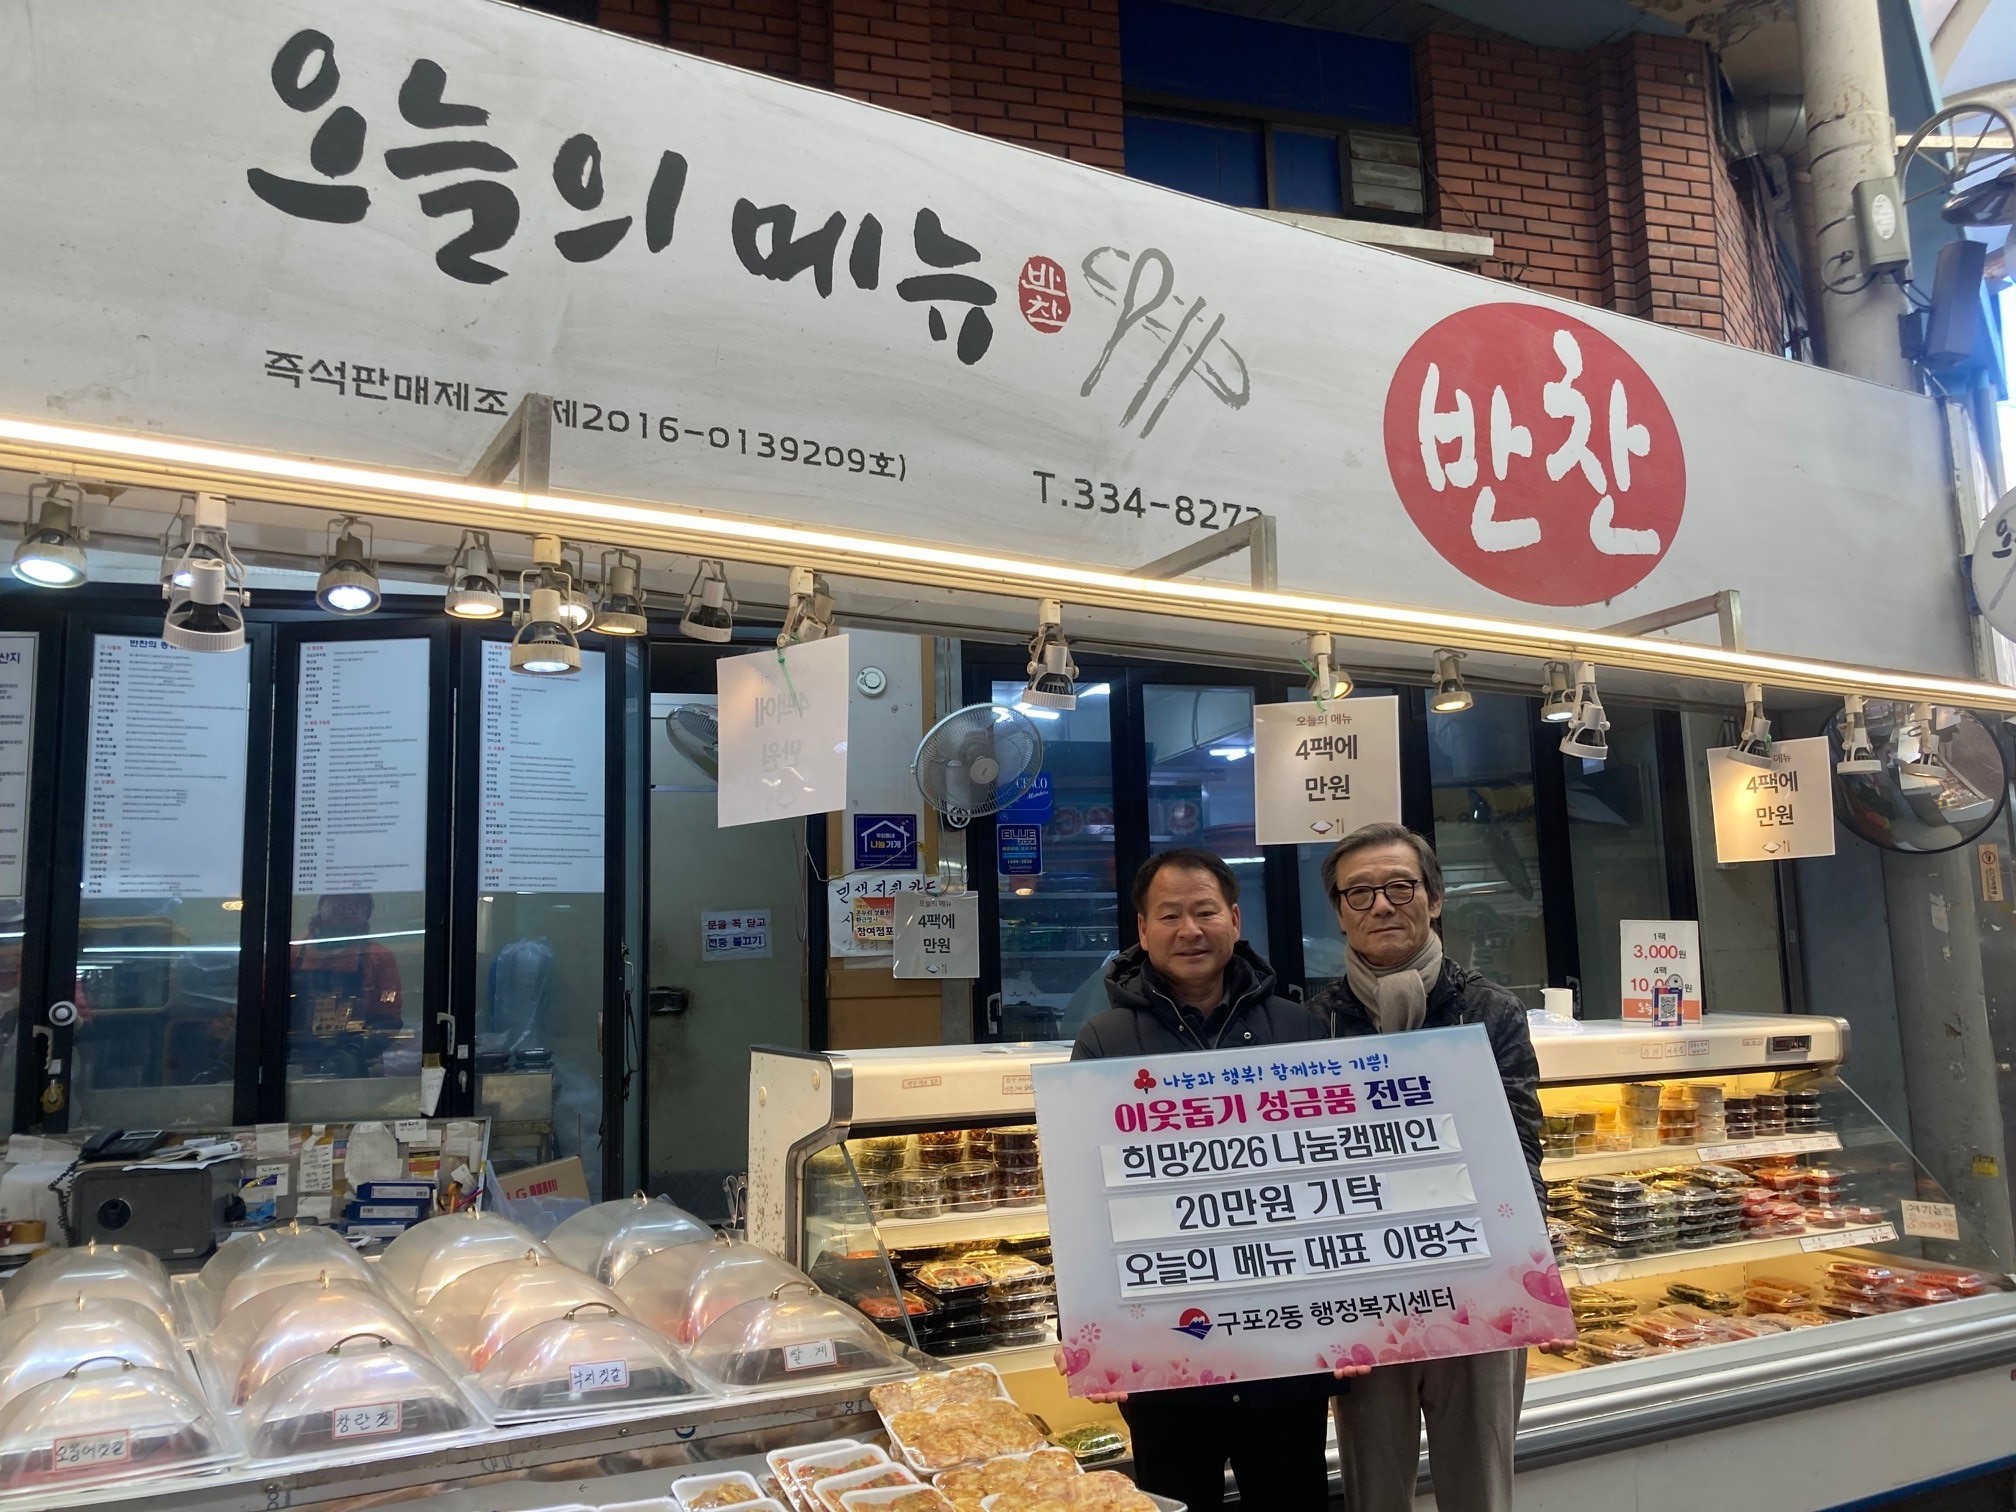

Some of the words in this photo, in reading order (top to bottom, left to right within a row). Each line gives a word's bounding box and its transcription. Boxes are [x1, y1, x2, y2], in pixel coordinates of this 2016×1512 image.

[247, 28, 687, 285] 오늘의
[732, 198, 997, 364] 메뉴
[265, 350, 508, 416] 즉석판매제조
[1418, 330, 1660, 555] 반찬
[1296, 715, 1327, 727] 오늘의
[1331, 713, 1352, 725] 메뉴
[1295, 734, 1357, 761] 4팩에
[1305, 774, 1350, 802] 만원
[1746, 771, 1798, 793] 4팩에
[1756, 804, 1794, 827] 만원
[1001, 829, 1037, 840] BLUE
[918, 913, 955, 929] 4팩에
[923, 938, 950, 954] 만원
[1653, 932, 1666, 941] 1팩
[1653, 966, 1667, 975] 4팩
[1163, 1073, 1215, 1090] 나눔과
[1221, 1066, 1263, 1086] 행복!
[1270, 1057, 1342, 1079] 함께하는
[1348, 1053, 1389, 1072] 기쁨!
[1114, 1094, 1247, 1133] 이웃돕기
[1256, 1083, 1357, 1122] 성금품
[1363, 1075, 1434, 1111] 전달
[1121, 1135, 1268, 1179] 희망2026
[1271, 1118, 1440, 1165] 나눔캠페인
[1176, 1184, 1296, 1230] 20만원
[1307, 1174, 1386, 1215] 기탁
[1125, 1248, 1220, 1287] 오늘의
[1232, 1242, 1297, 1277] 메뉴
[1304, 1232, 1370, 1270] 대표
[1383, 1220, 1478, 1259] 이명수
[1216, 1304, 1303, 1336] 구포2동
[1309, 1286, 1456, 1326] 행정복지센터
